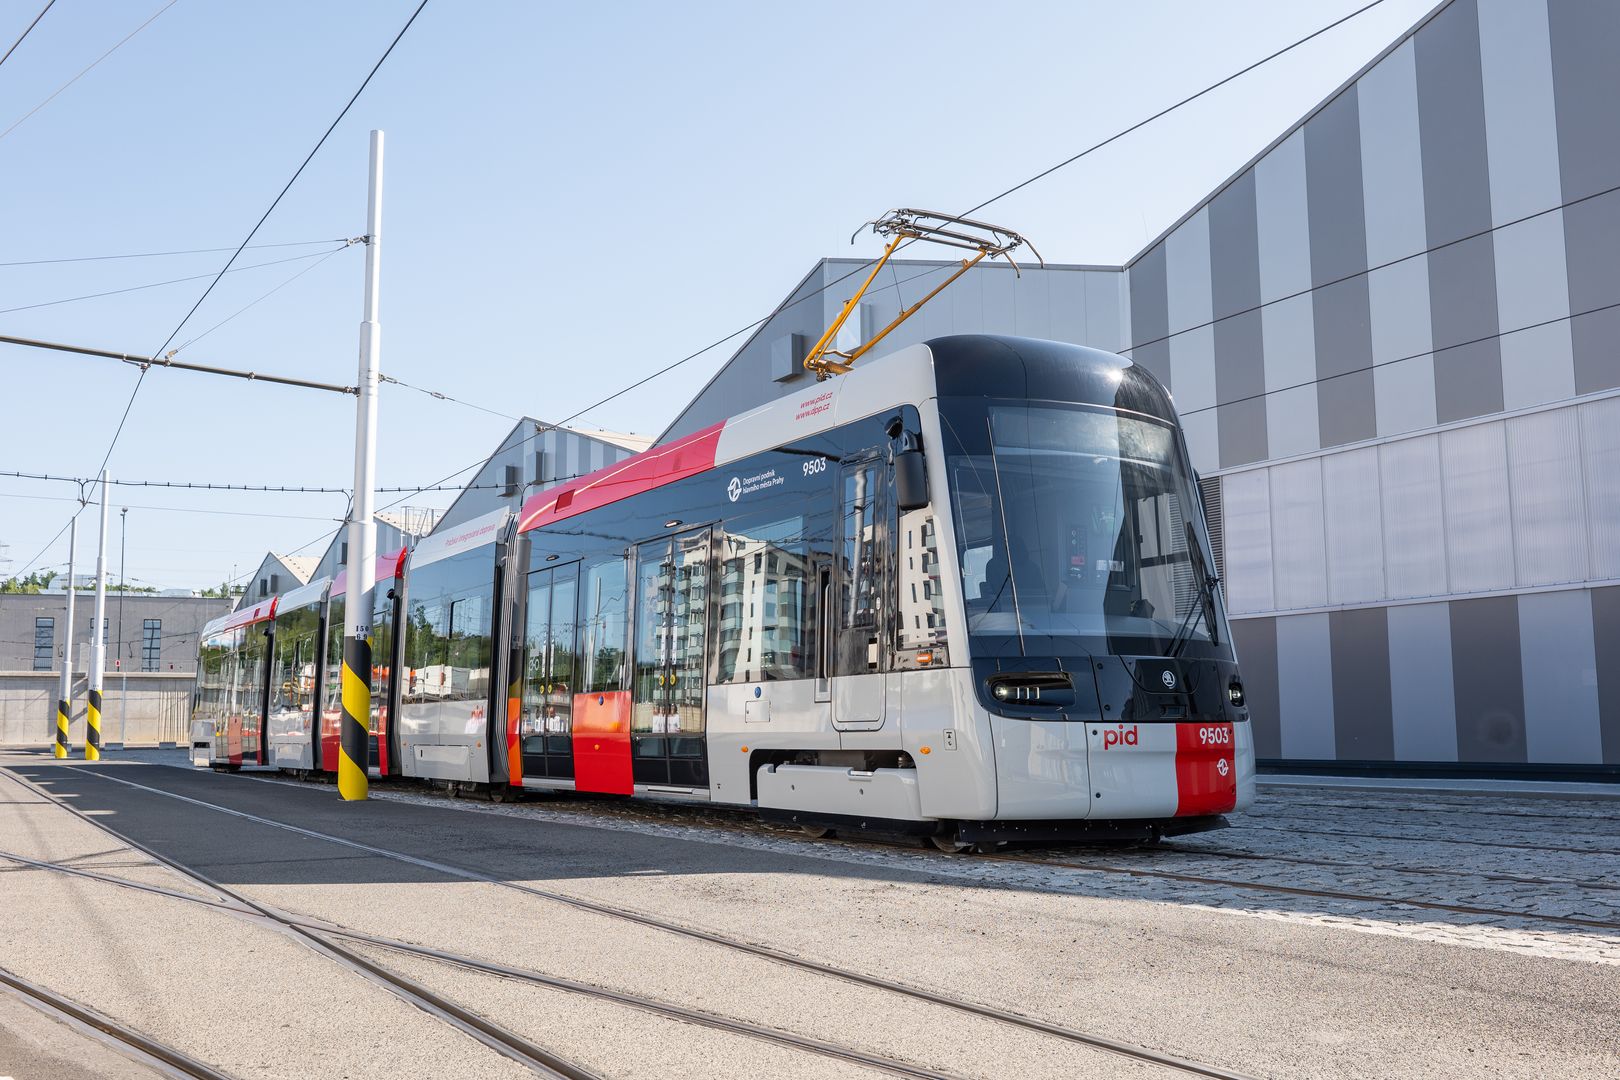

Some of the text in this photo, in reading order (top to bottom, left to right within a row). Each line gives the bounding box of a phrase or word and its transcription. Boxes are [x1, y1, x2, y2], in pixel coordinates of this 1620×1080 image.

[800, 391, 833, 409] www.pid.cz
[795, 403, 830, 420] www.dpp.cz
[760, 469, 775, 481] podnik
[802, 457, 827, 477] 9503
[772, 476, 785, 485] Prahy
[1104, 724, 1138, 750] pid
[1200, 727, 1229, 745] 9503
